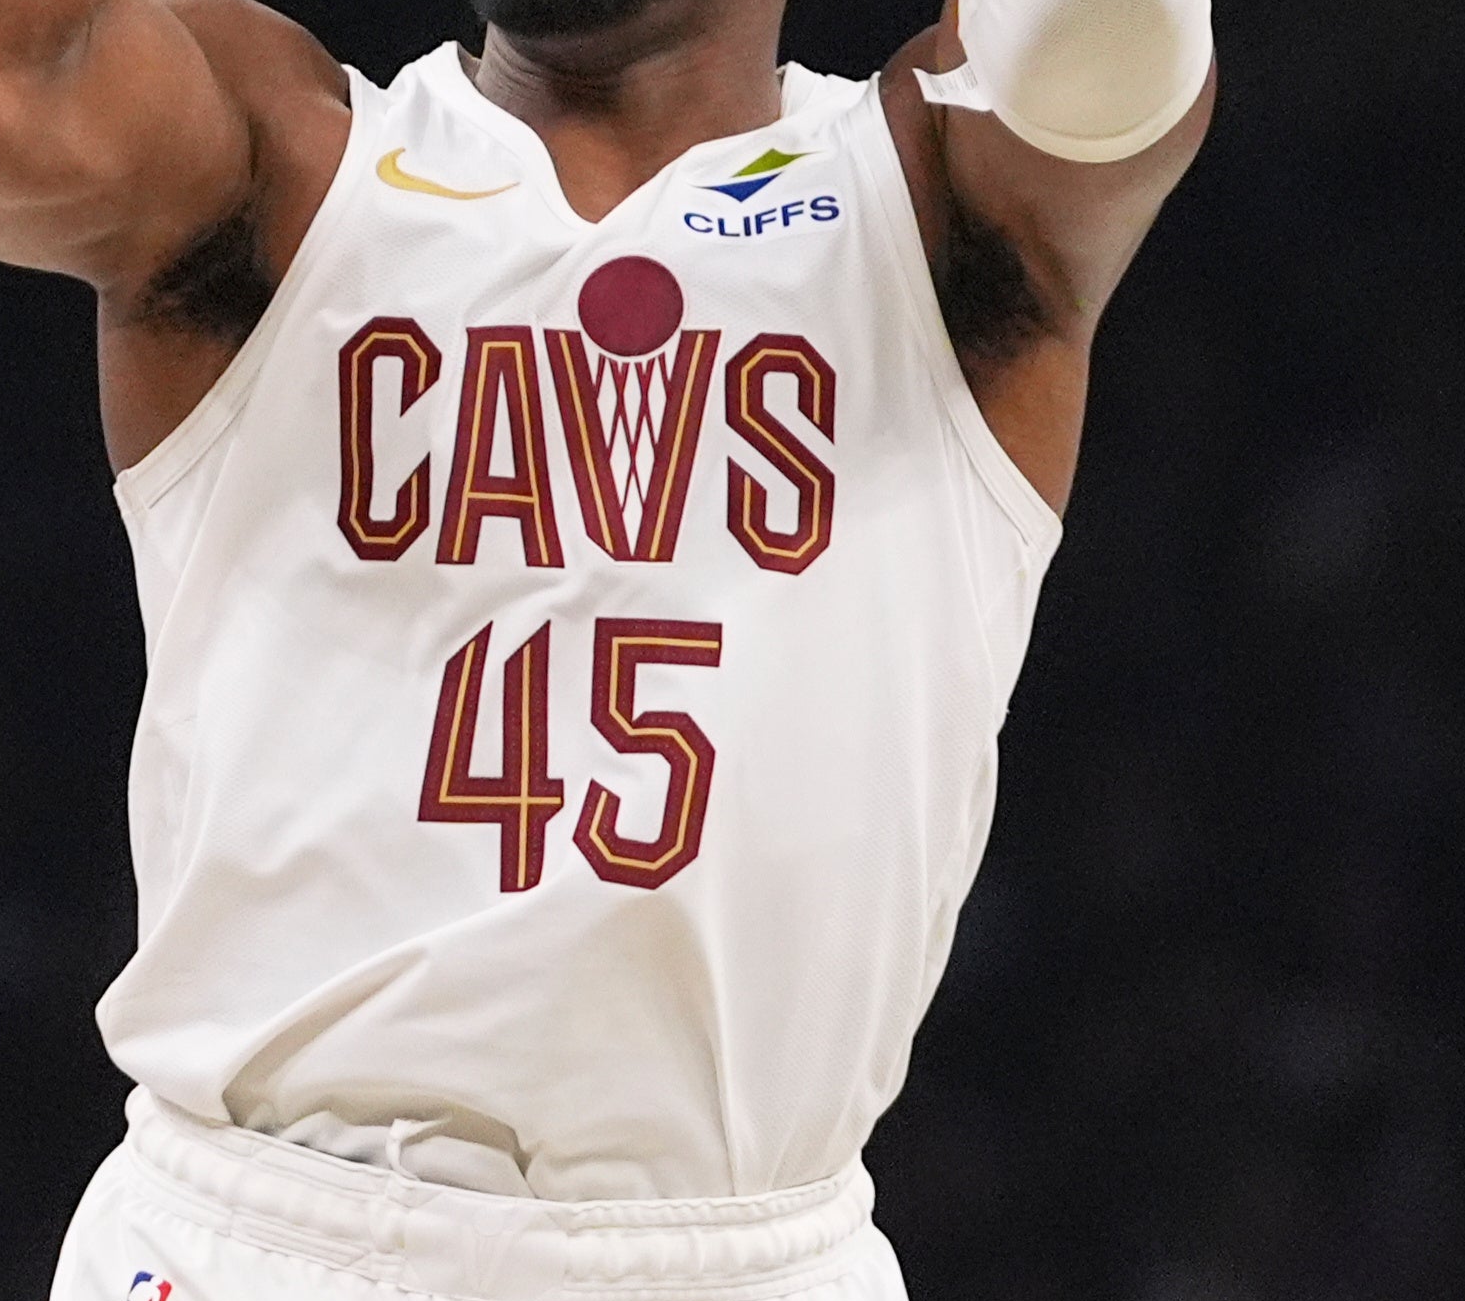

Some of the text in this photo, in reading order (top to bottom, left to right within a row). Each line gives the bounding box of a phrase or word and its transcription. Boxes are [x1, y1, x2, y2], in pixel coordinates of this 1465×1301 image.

[684, 195, 840, 237] CLIFFS
[337, 315, 837, 576] CAVS
[417, 617, 722, 893] 45
